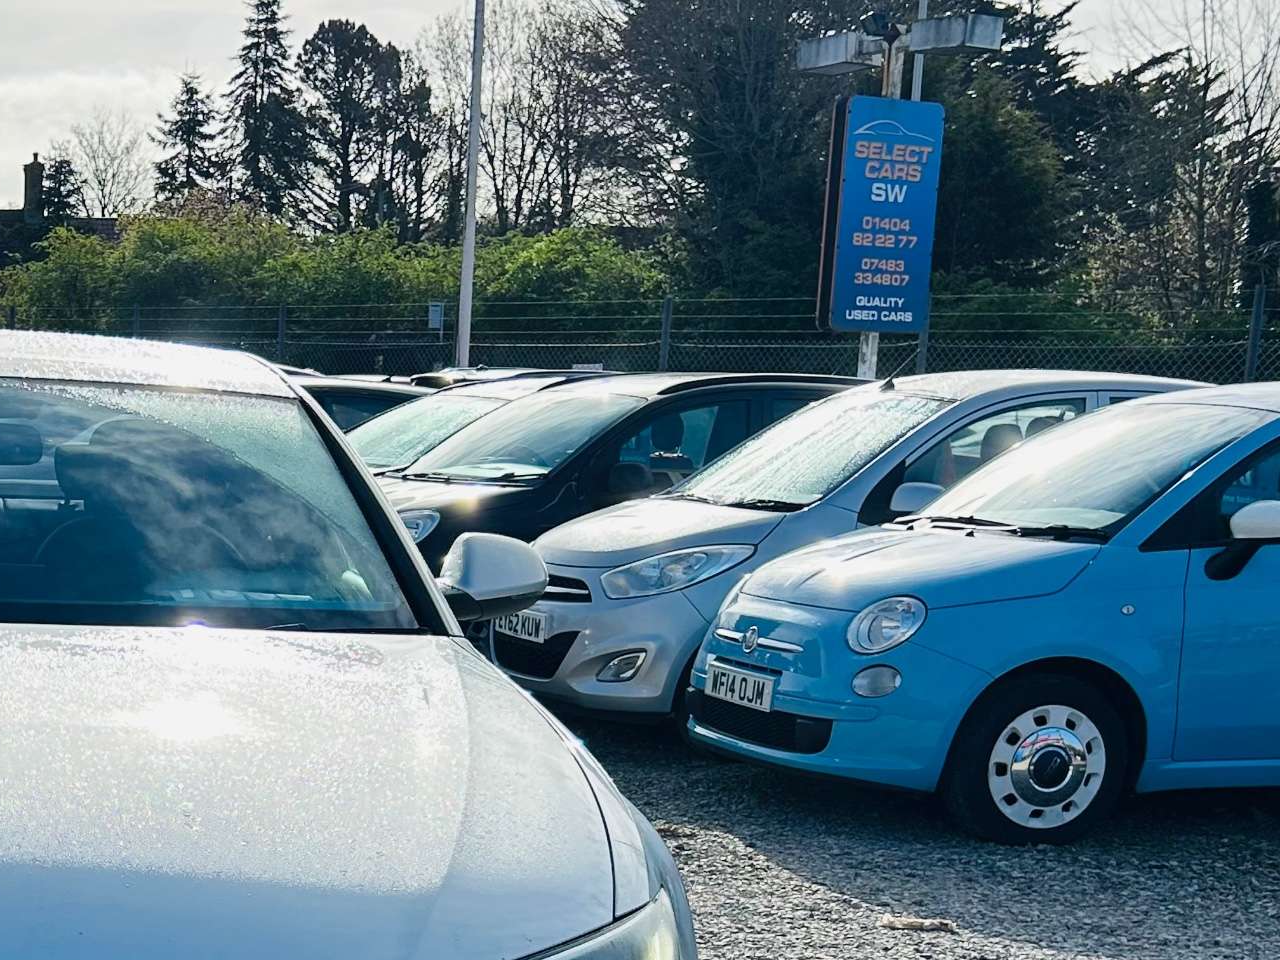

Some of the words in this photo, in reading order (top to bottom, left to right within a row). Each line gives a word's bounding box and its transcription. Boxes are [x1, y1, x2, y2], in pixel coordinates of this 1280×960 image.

[854, 141, 932, 163] SELECT
[865, 162, 922, 182] CARS
[871, 183, 907, 203] SW
[862, 216, 911, 232] 01404
[861, 258, 905, 272] 07483
[854, 273, 910, 287] 334807
[856, 296, 905, 308] QUALITY
[845, 310, 878, 321] USED
[881, 311, 913, 322] CARS
[738, 677, 766, 706] OJM
